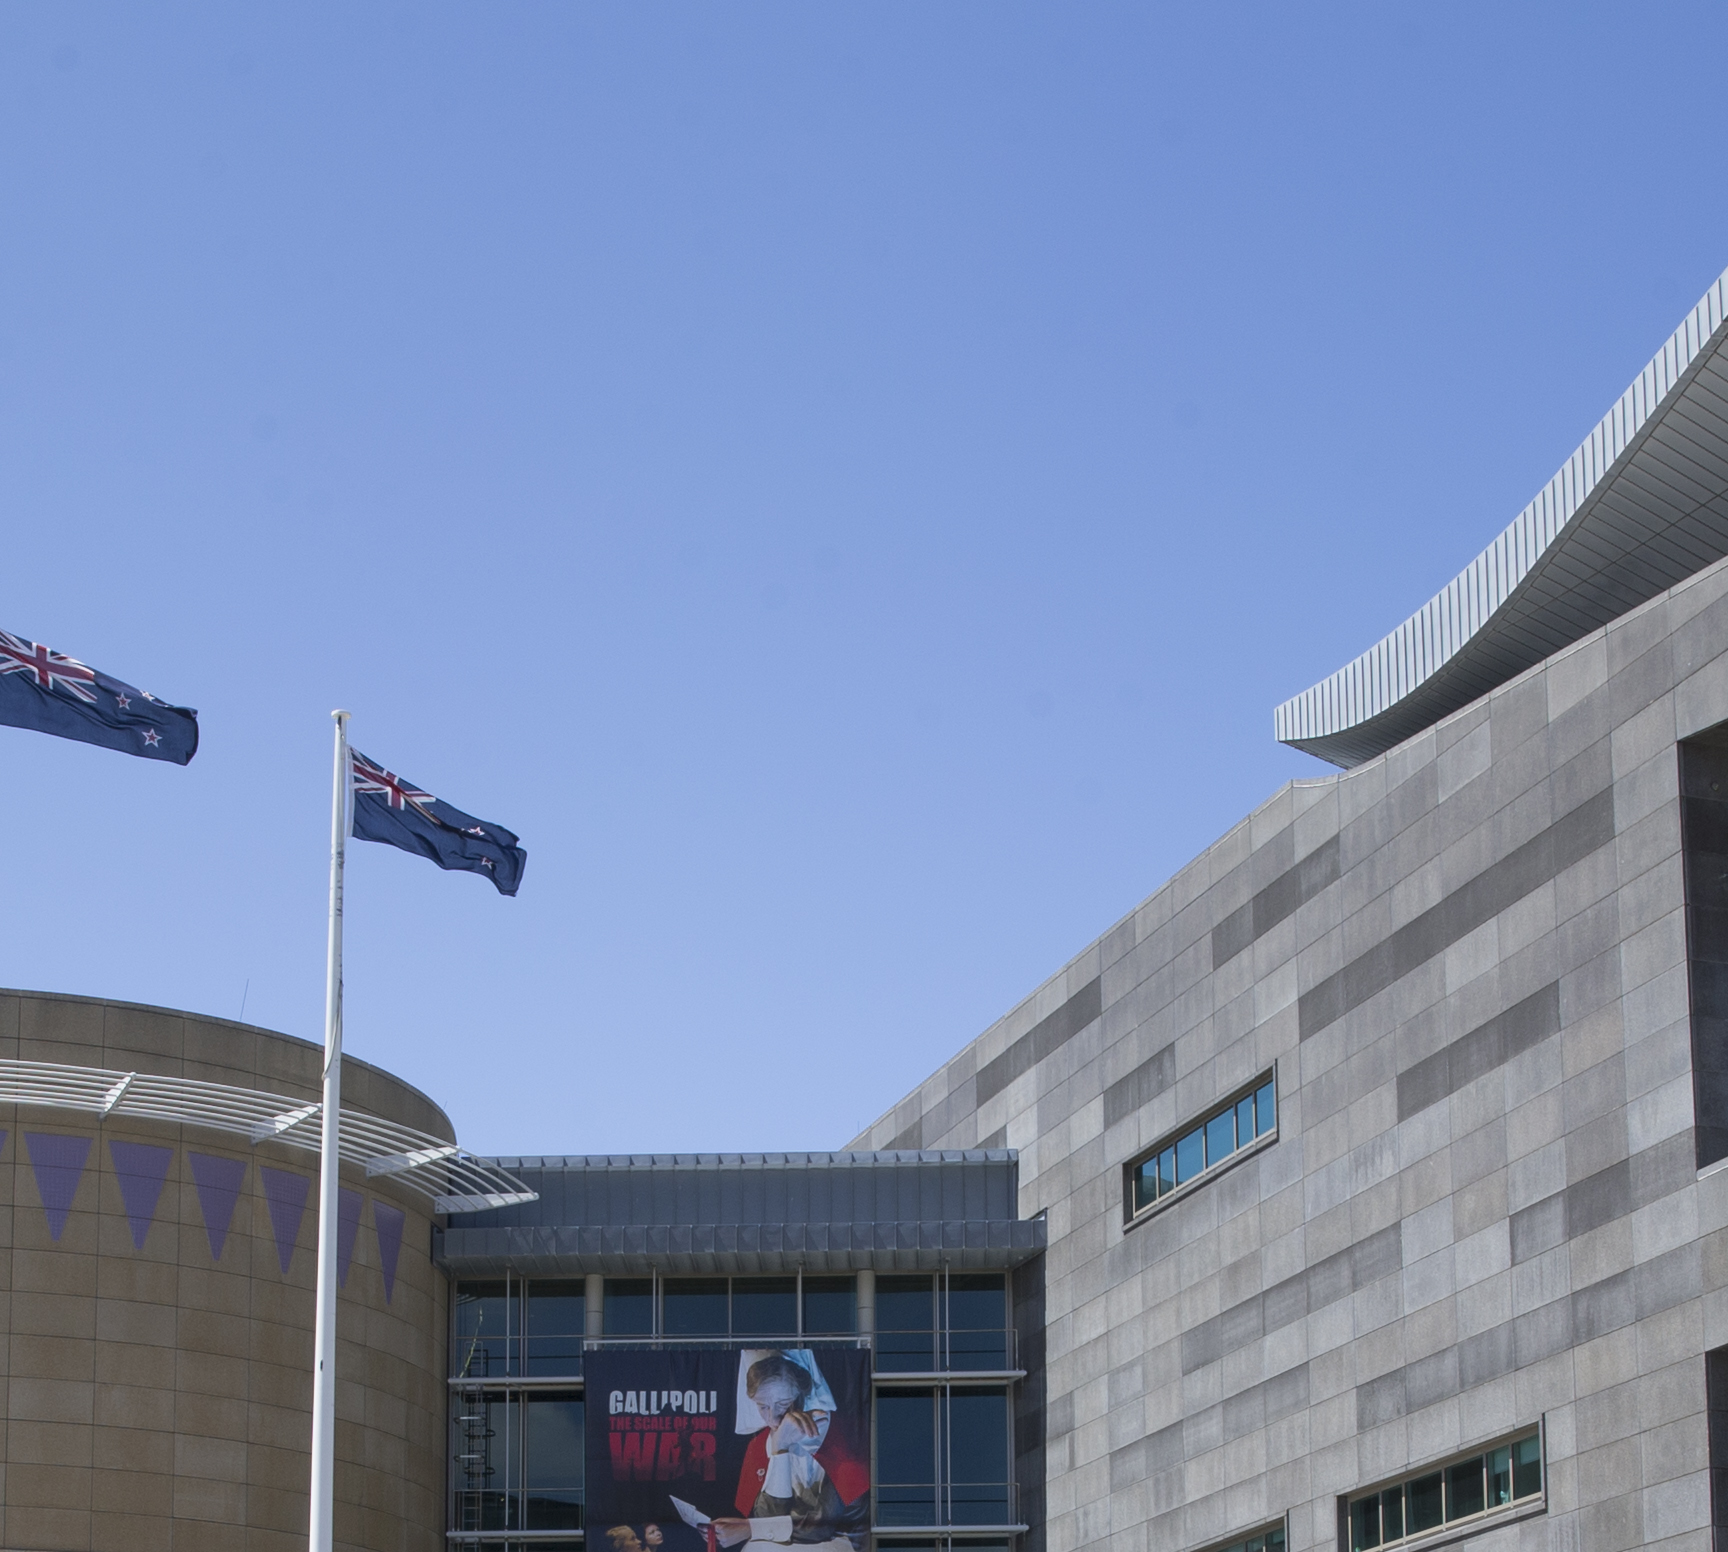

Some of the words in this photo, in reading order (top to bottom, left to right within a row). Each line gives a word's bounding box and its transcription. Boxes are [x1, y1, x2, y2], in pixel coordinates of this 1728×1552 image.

[609, 1389, 718, 1415] GALLIPOLI
[609, 1416, 631, 1431] THE
[634, 1416, 671, 1431] SCALE
[673, 1416, 688, 1431] OF
[691, 1416, 717, 1431] OUR
[609, 1432, 717, 1481] WAR
